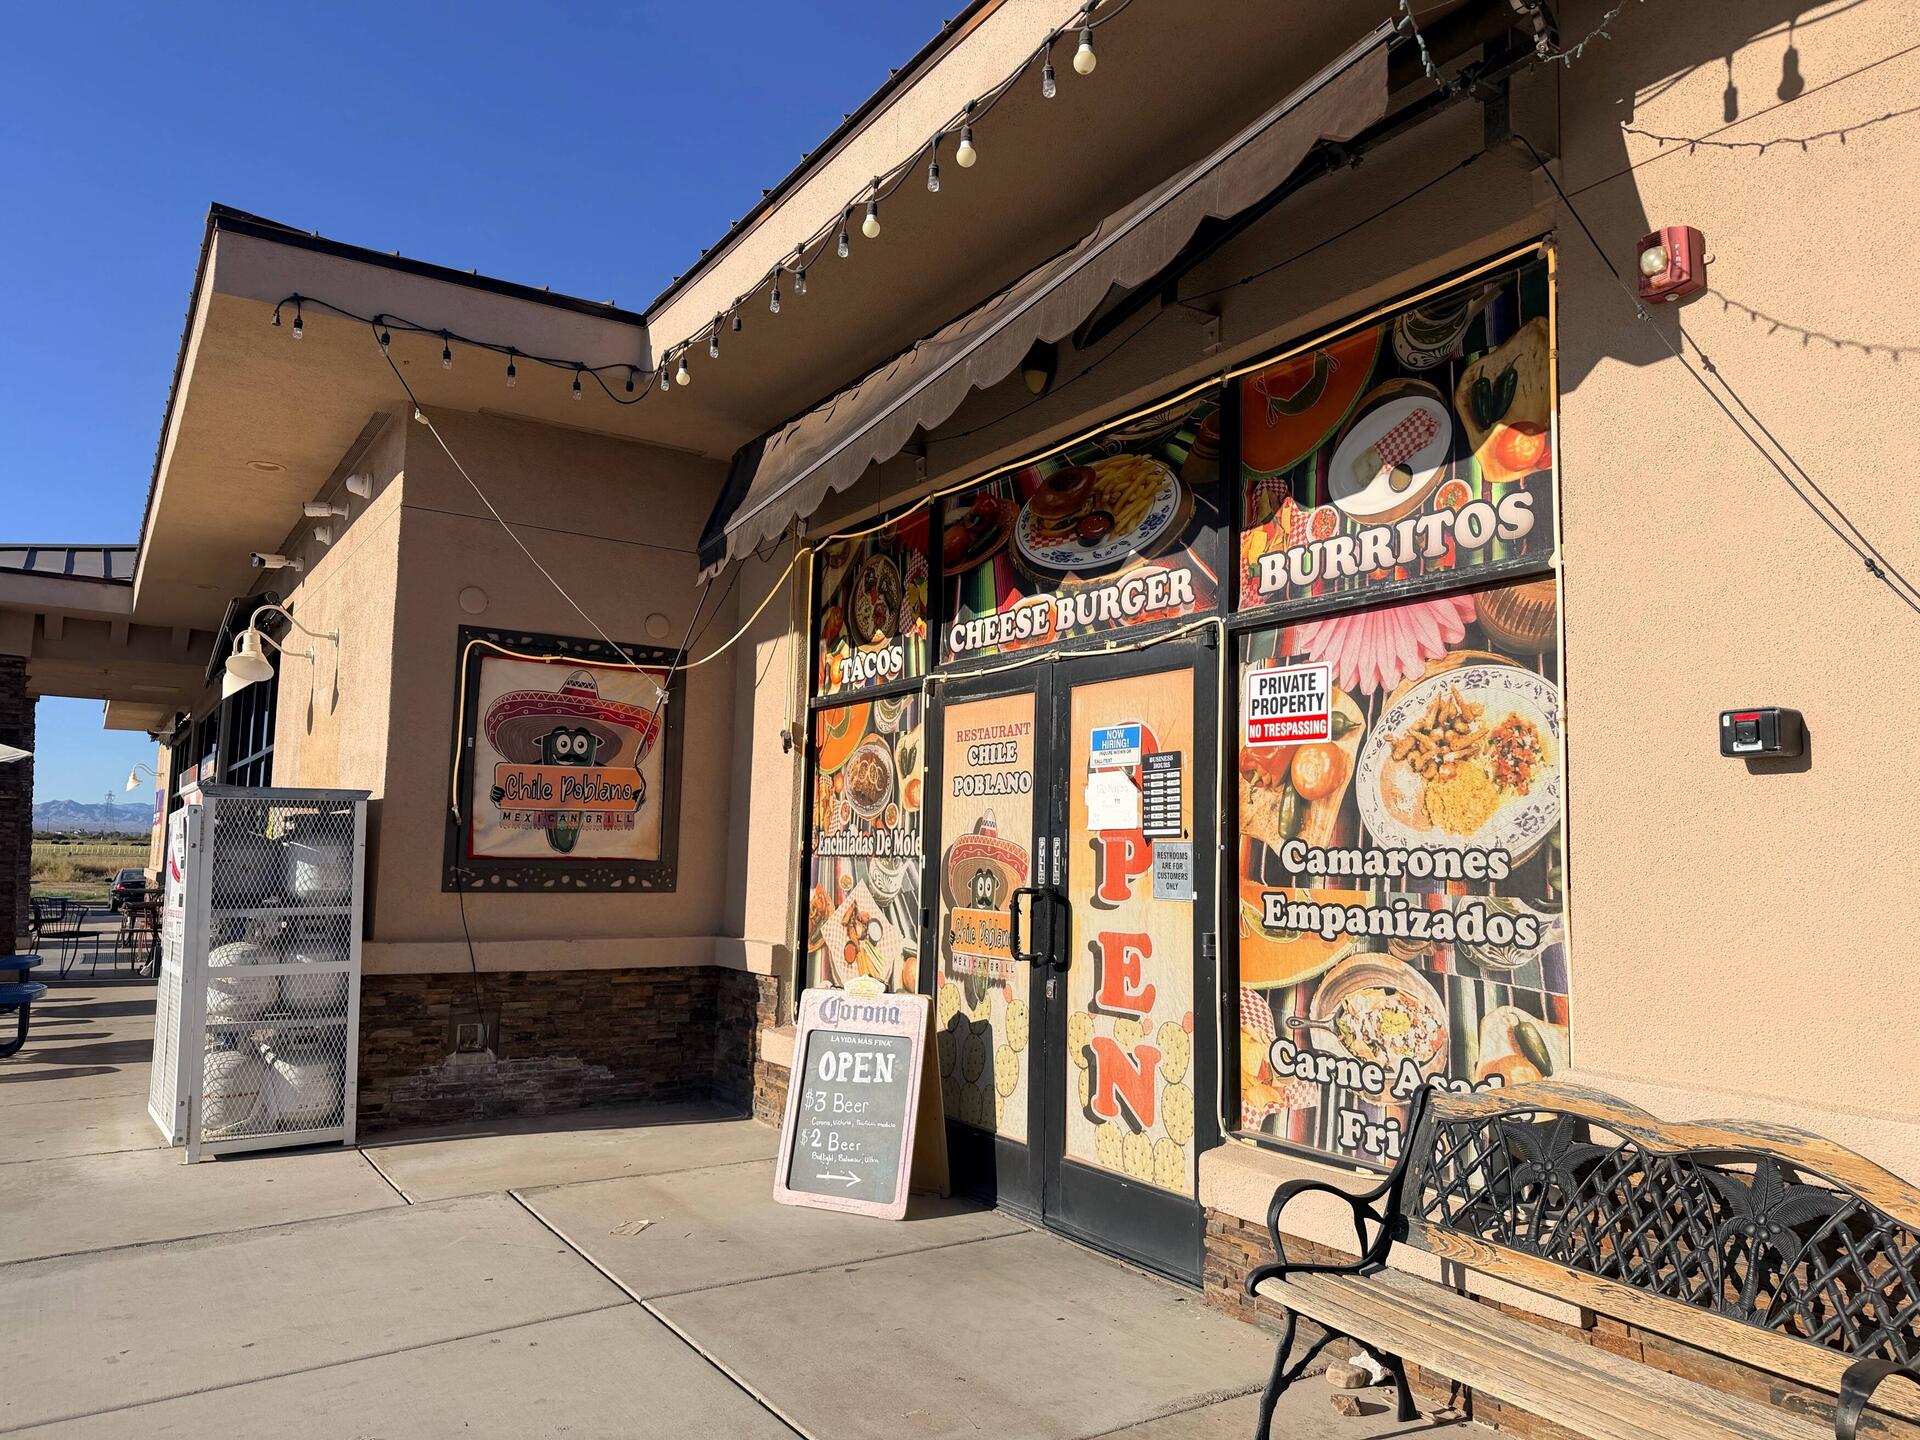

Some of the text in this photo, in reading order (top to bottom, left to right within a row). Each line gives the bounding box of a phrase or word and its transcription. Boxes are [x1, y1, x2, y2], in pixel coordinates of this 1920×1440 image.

[1258, 491, 1535, 595] BURRITOS
[949, 568, 1195, 653] CHEESE BURGER
[840, 646, 903, 684] TACOS
[1259, 672, 1317, 696] PRIVATE
[1251, 693, 1325, 716] PROPERTY
[956, 721, 1031, 743] RESTAURANT
[1106, 729, 1125, 740] NOW
[1250, 718, 1327, 739] NO TRESPASSING
[967, 741, 1017, 766] CHILE
[1102, 738, 1130, 749] HIRING!
[1149, 754, 1174, 764] BUSINESS
[504, 772, 633, 804] Chile Poblano
[953, 772, 1032, 797] POBLANO
[503, 812, 634, 824] MEXICAN GRILL
[818, 829, 920, 857] Enchiladas De Mole
[1156, 851, 1188, 860] RESTROOMS
[1161, 862, 1183, 870] ARE FOR
[1280, 839, 1511, 880] Camarones
[1156, 871, 1188, 881] CUSTOMERS
[1165, 881, 1179, 890] ONLY
[1086, 721, 1161, 1131] PEN
[1263, 891, 1541, 949] Empanizados
[953, 955, 1014, 973] MEXICAN GRILL
[819, 996, 900, 1028] Corona
[831, 1035, 840, 1043] LA
[840, 1036, 856, 1045] VIDA
[818, 1051, 896, 1083] OPEN
[1270, 1037, 1385, 1094] Carne
[805, 1088, 869, 1113] $3 Beer
[828, 1131, 861, 1151] Beer
